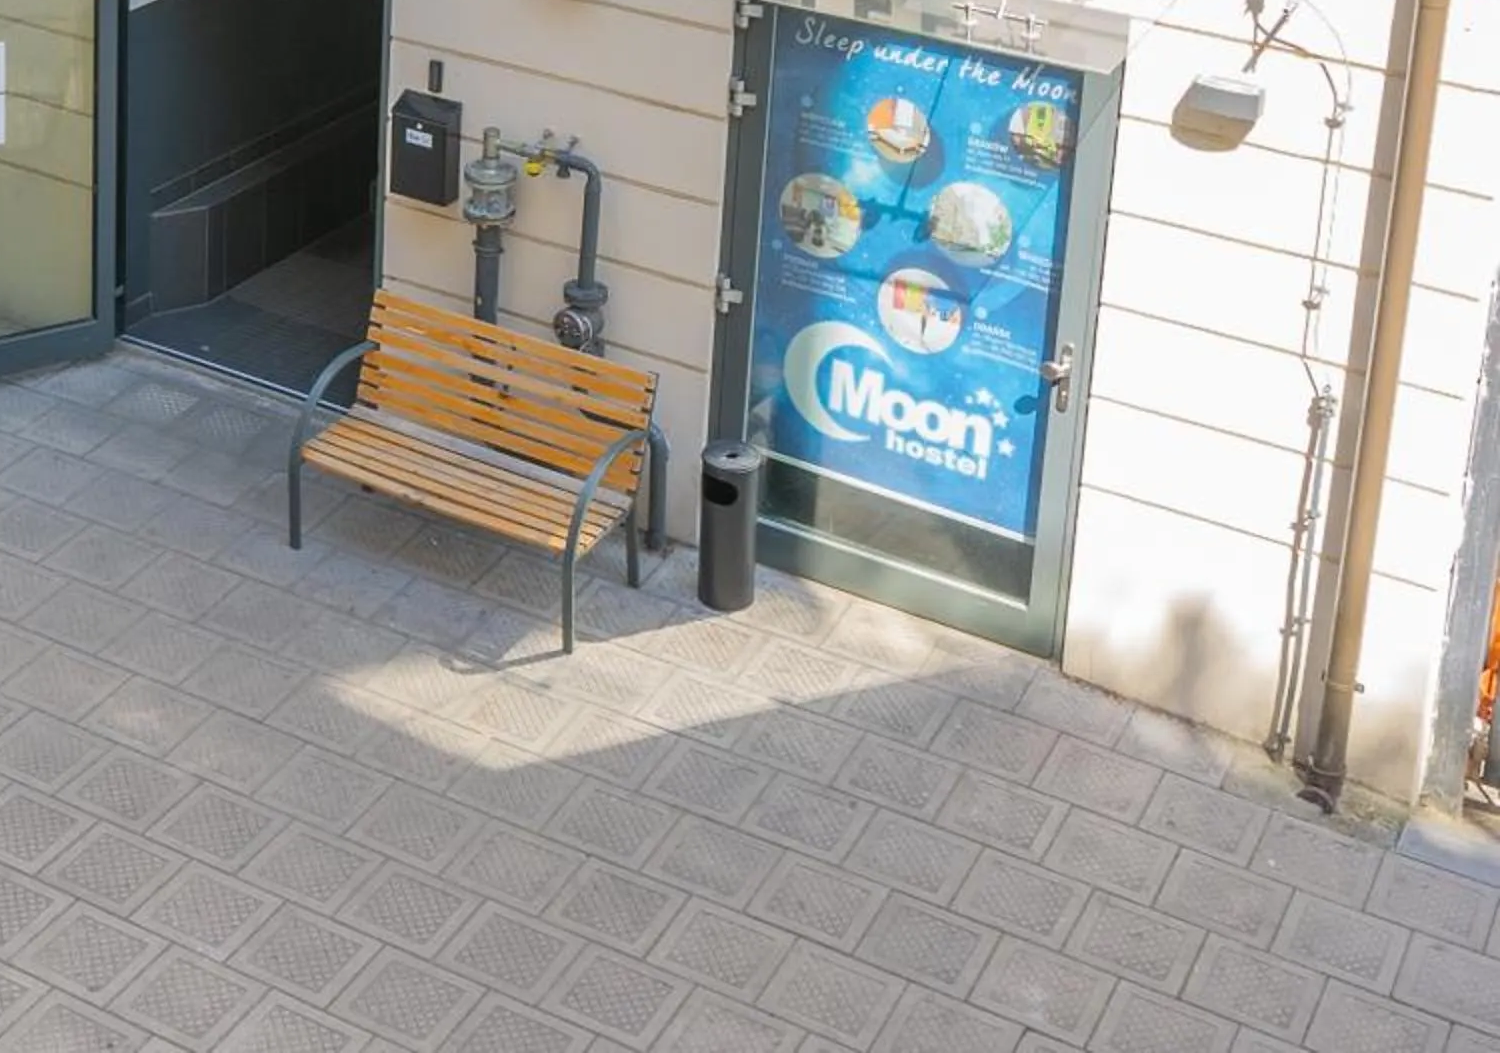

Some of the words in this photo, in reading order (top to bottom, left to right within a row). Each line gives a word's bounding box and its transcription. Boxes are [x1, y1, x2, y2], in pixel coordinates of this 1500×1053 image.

[795, 17, 864, 60] Sleep
[873, 44, 949, 74] under
[959, 55, 1001, 85] the
[1012, 64, 1078, 104] Moon
[828, 358, 993, 458] Moon
[886, 428, 988, 481] hostel
